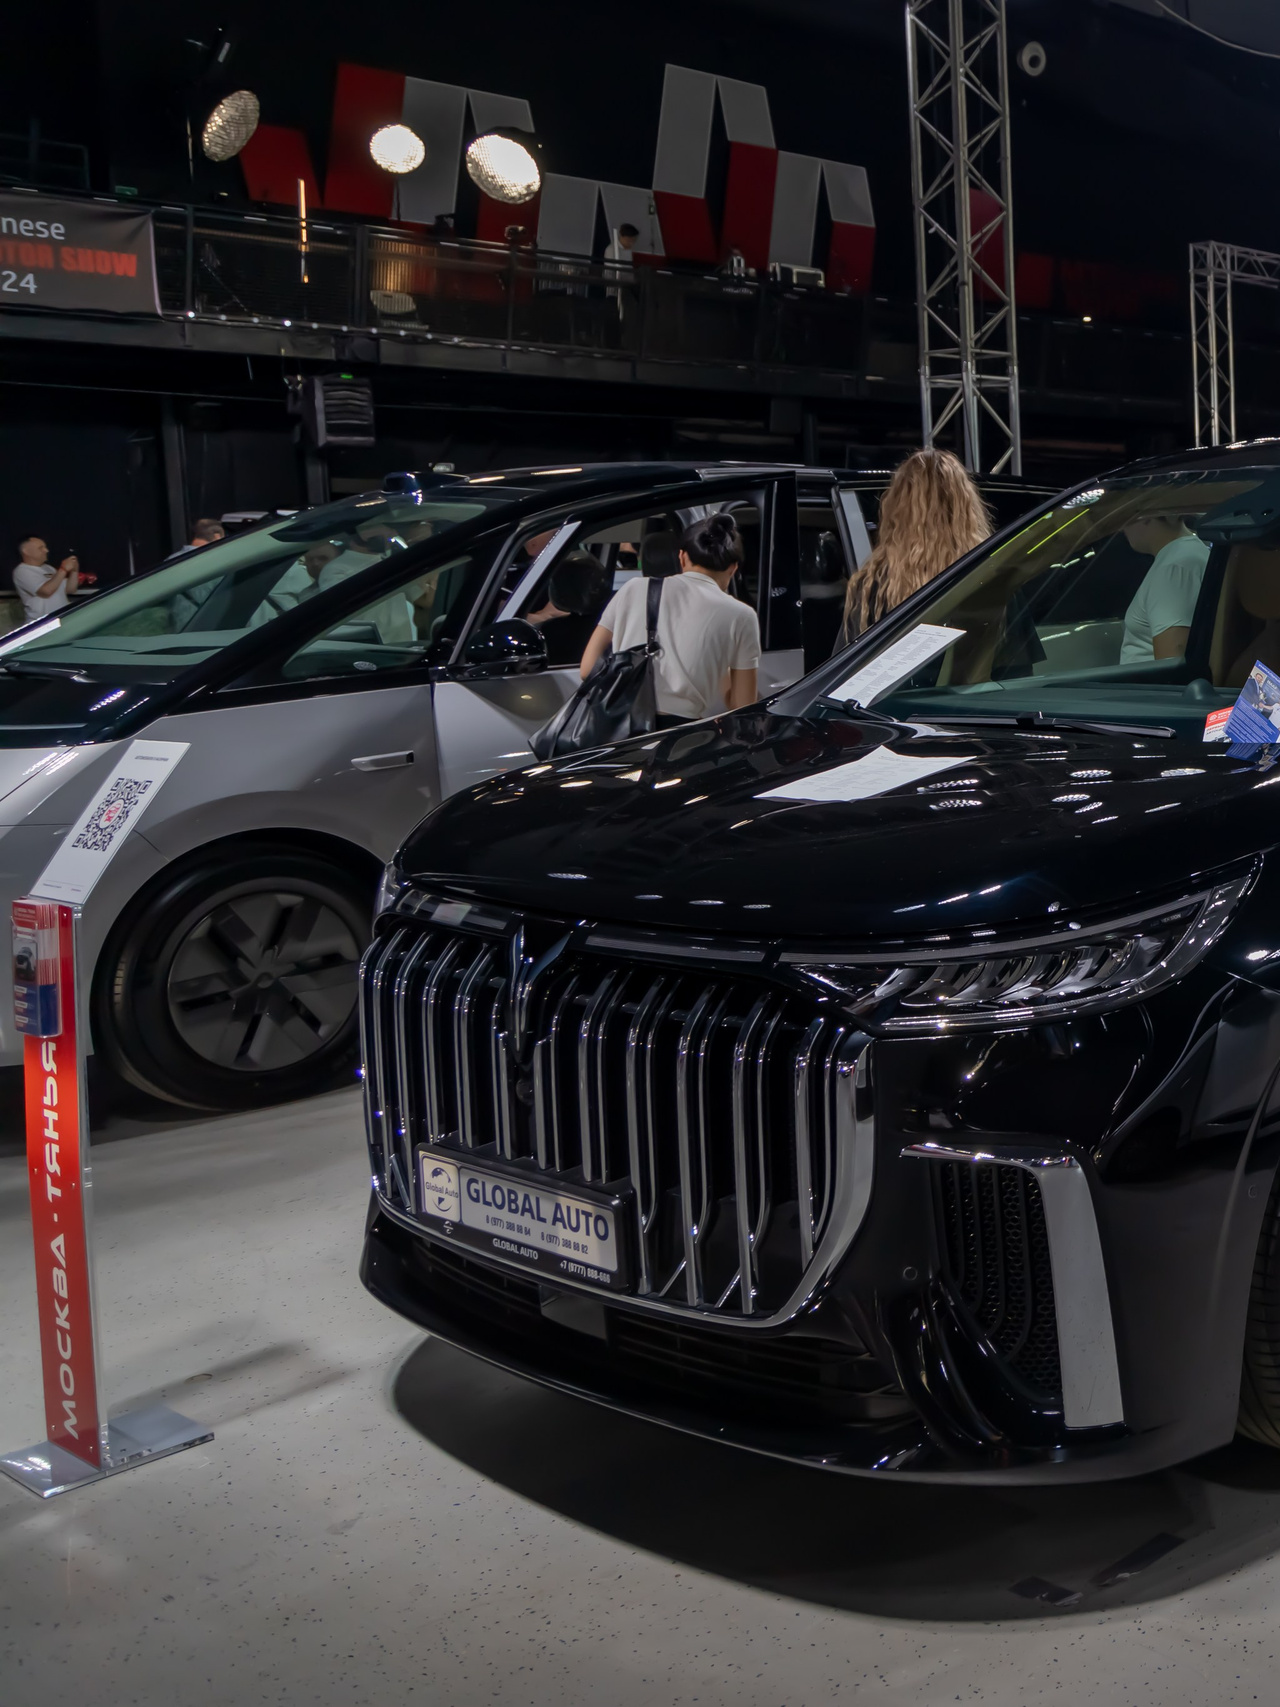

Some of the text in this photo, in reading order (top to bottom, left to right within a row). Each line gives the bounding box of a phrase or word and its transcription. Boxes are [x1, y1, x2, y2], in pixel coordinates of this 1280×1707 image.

[1, 216, 66, 240] nese
[60, 246, 138, 278] SHOW
[425, 1181, 459, 1198] Global Auto
[466, 1177, 609, 1241] GLOBAL AUTO
[492, 1238, 539, 1260] GLOBAL AUTO
[50, 1233, 79, 1439] МОСКВА
